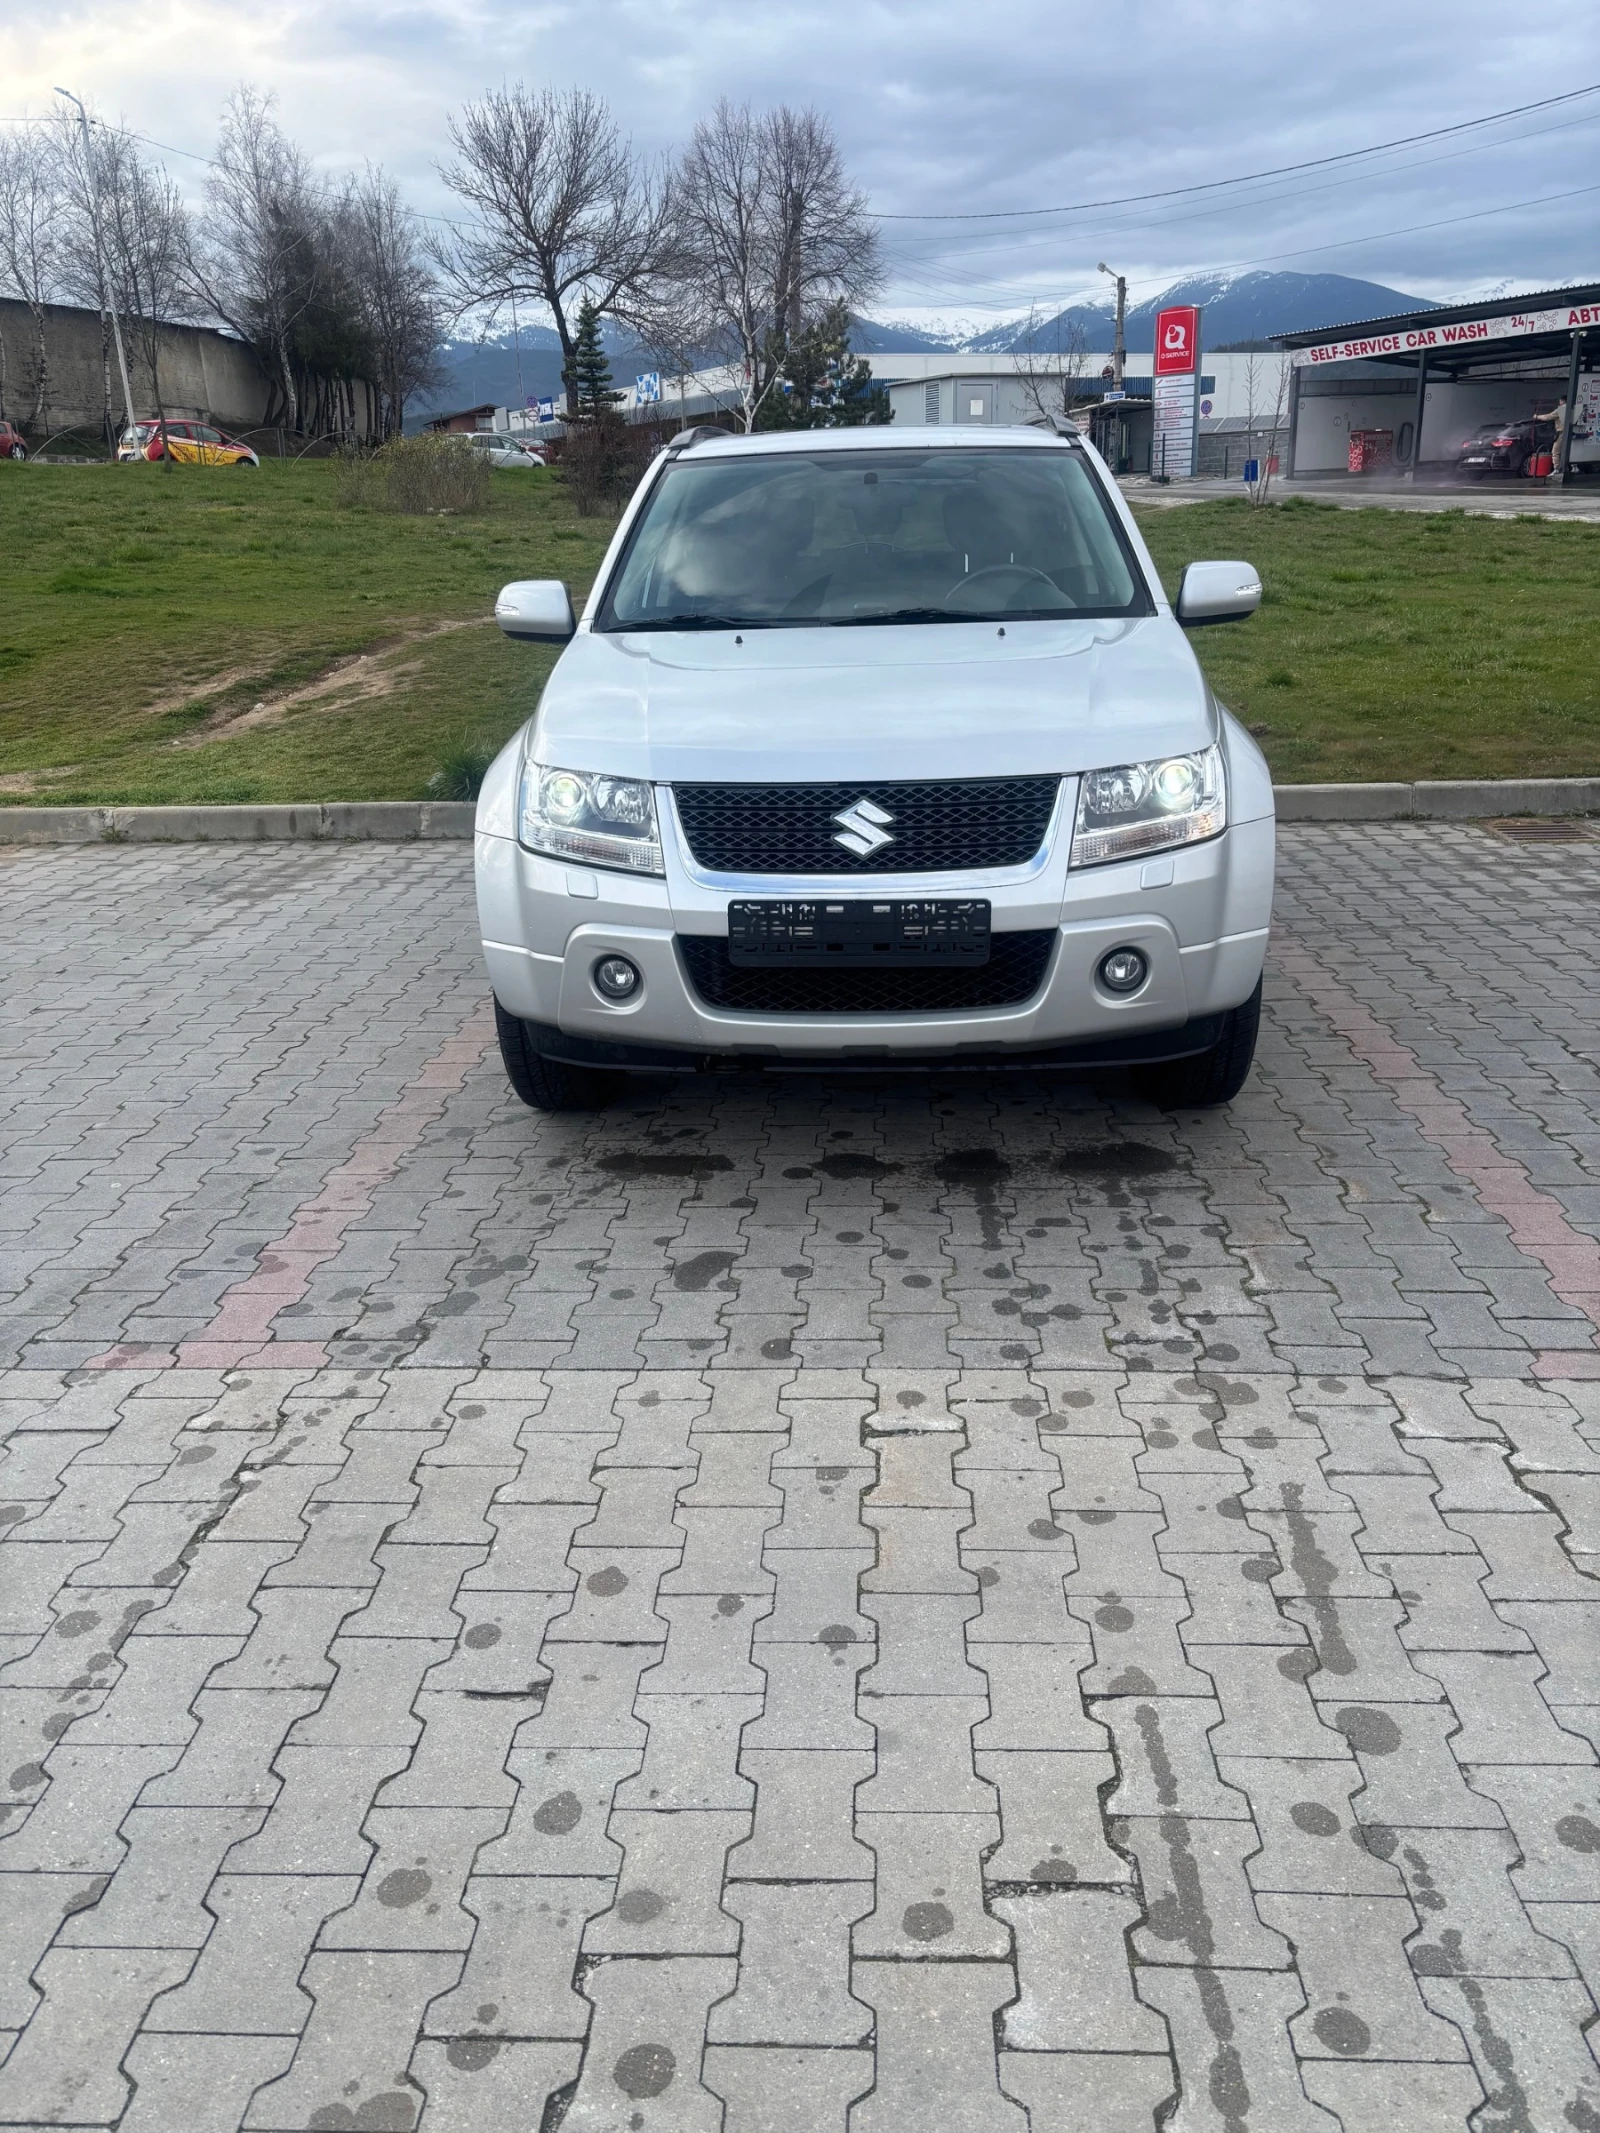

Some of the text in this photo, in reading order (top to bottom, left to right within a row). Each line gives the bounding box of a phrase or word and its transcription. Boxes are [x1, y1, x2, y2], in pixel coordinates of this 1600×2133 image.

[1310, 315, 1535, 362] SELF-SERVICE CAR WASH 24/7
